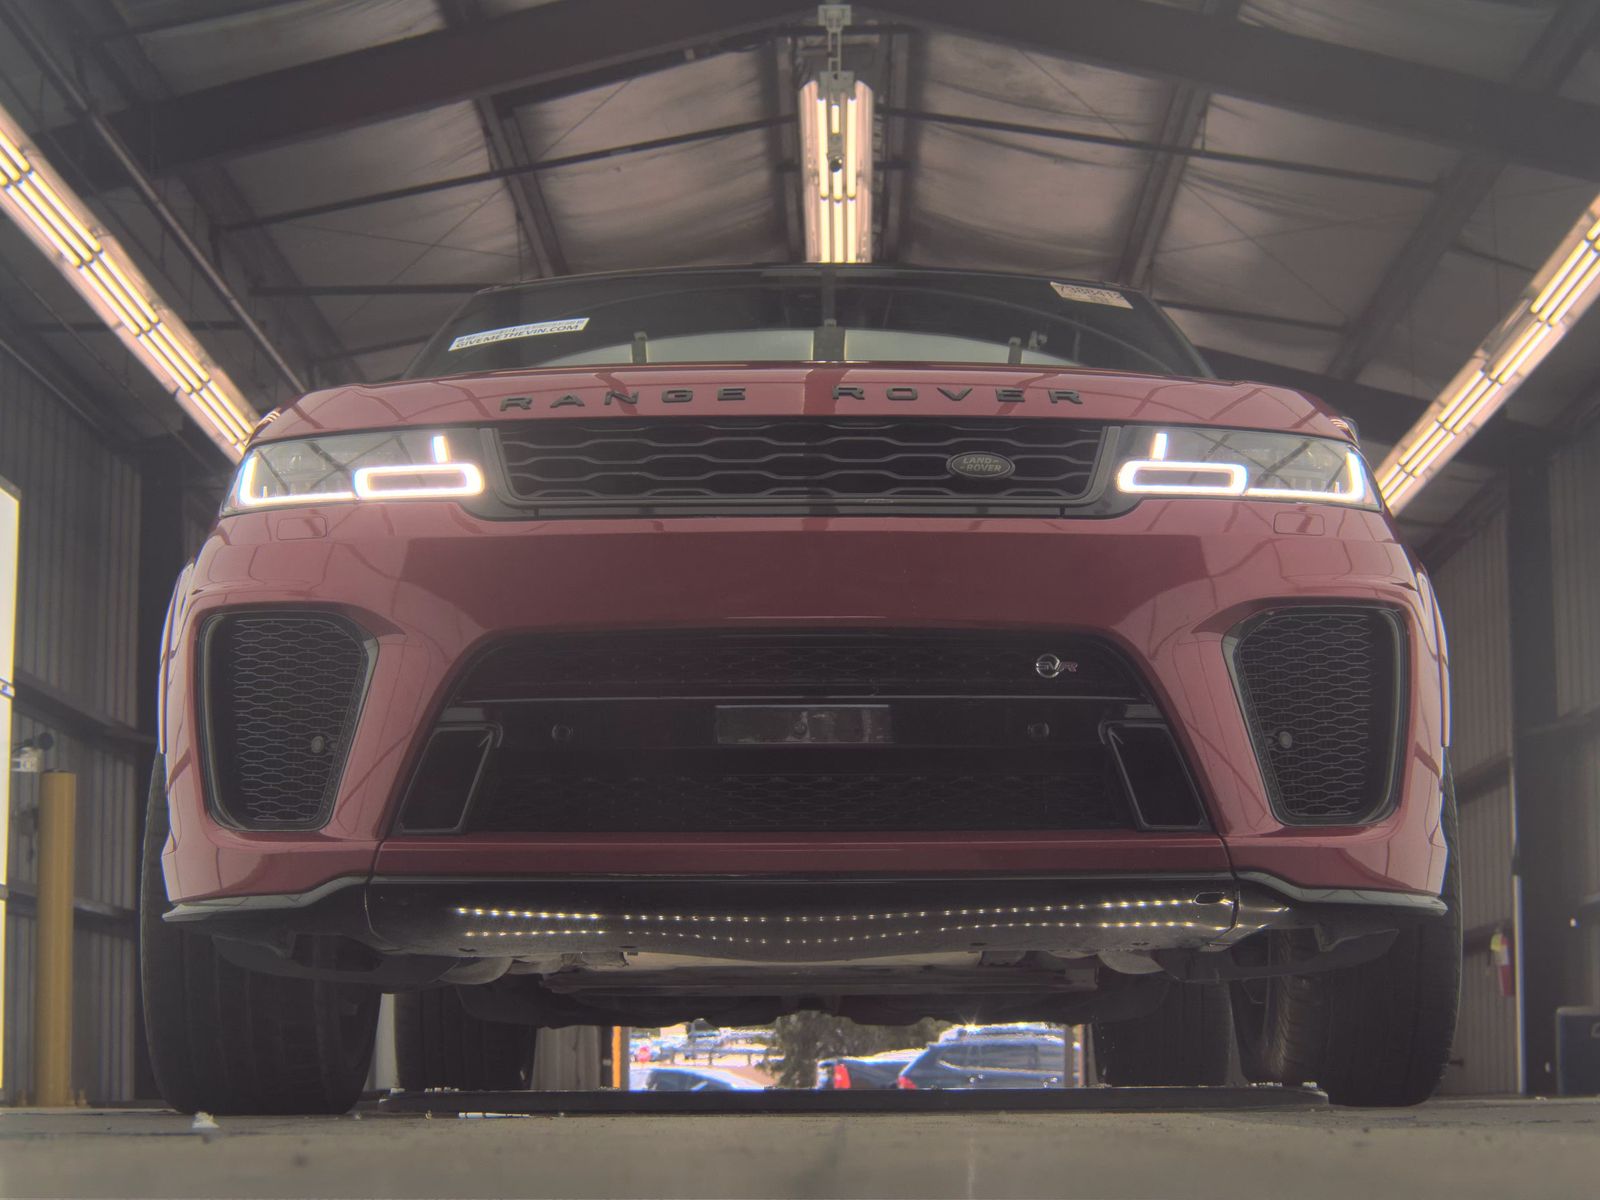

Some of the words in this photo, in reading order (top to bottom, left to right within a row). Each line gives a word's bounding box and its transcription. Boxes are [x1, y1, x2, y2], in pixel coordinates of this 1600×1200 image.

[455, 324, 579, 348] GIVEMETHEVIN.COM
[499, 387, 746, 411] RANGE
[831, 384, 1083, 405] ROVER
[966, 463, 1002, 473] ROVER
